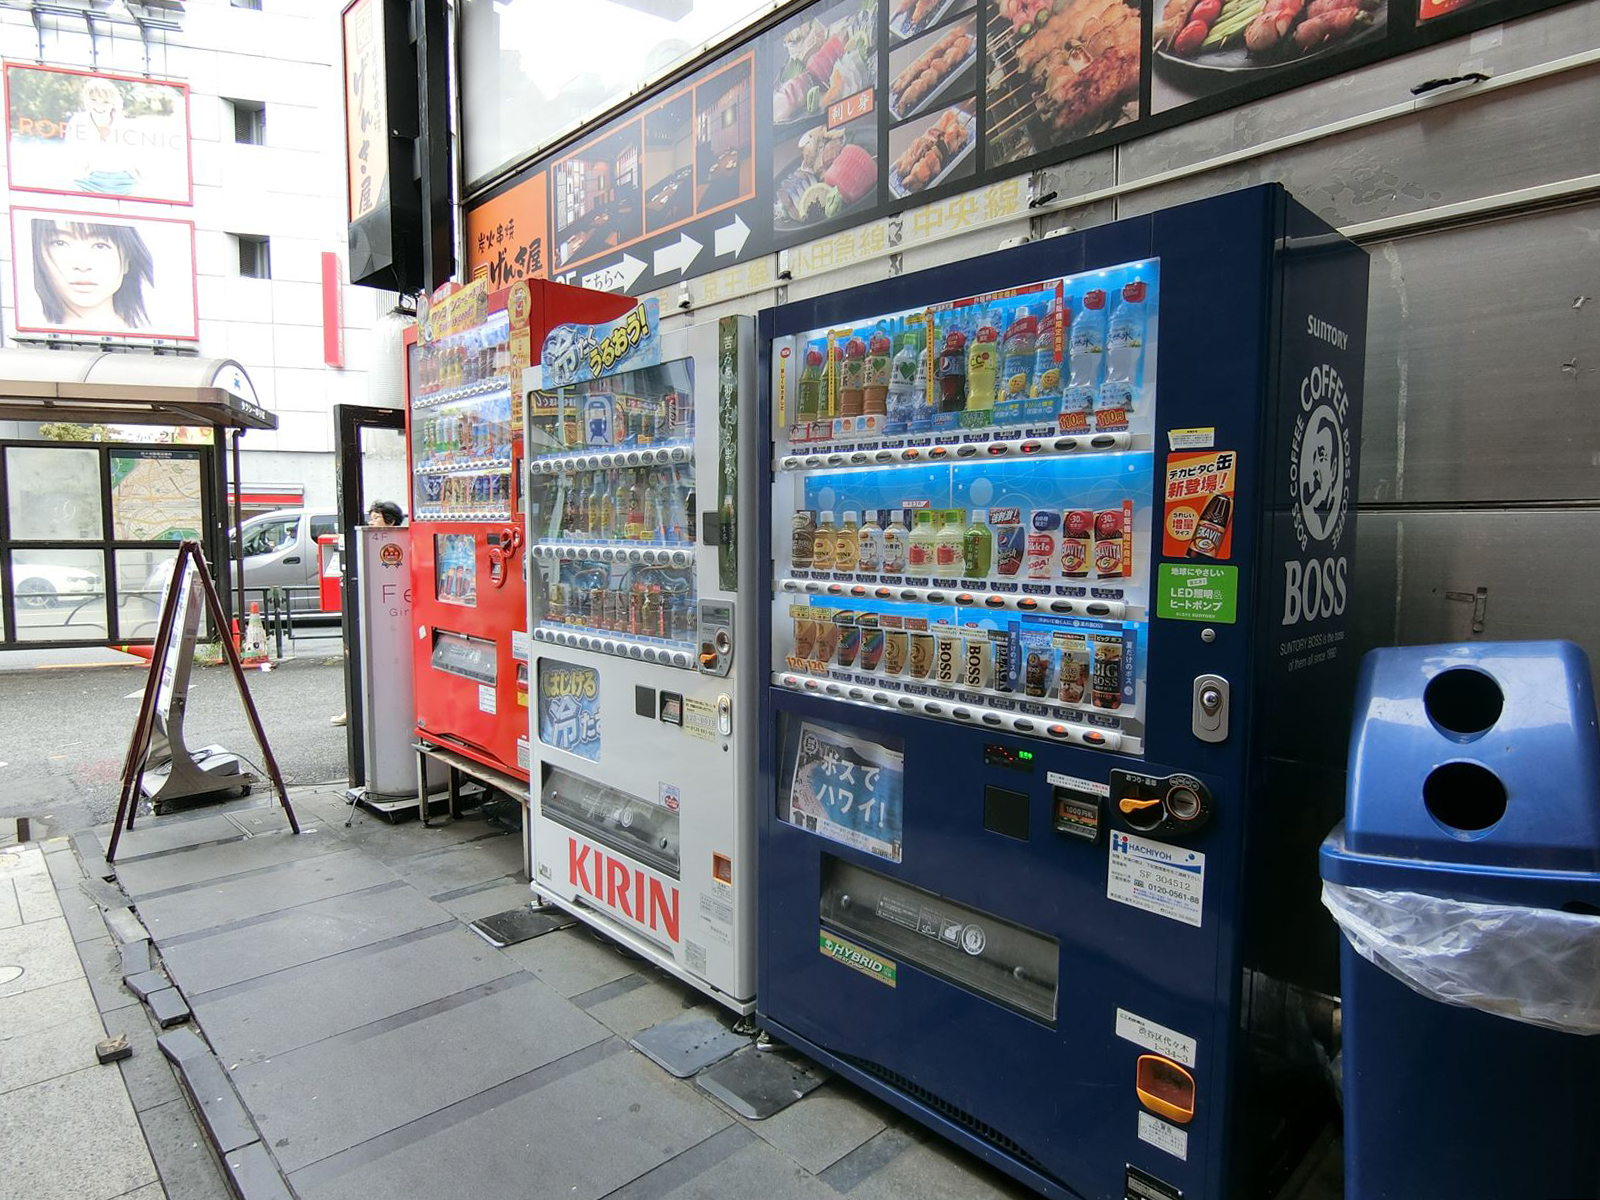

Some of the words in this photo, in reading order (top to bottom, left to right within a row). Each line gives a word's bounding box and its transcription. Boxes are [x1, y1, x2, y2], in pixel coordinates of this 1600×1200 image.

[832, 93, 871, 123] 刺し身
[914, 180, 1020, 236] 中央線
[478, 218, 514, 254] 炭火串焼
[490, 237, 543, 290] げんき屋
[588, 303, 650, 378] うるおう!
[1307, 314, 1350, 350] SUNTORY
[1300, 364, 1350, 425] COFFEE
[1096, 409, 1125, 427] 110円
[1289, 413, 1305, 497] COFFEE
[1167, 472, 1228, 498] 新登場!
[1172, 519, 1194, 530] 増量
[1291, 502, 1309, 552] BOSS
[1171, 567, 1225, 577] 地球にやさしい
[1170, 600, 1223, 611] ヒートポンプ
[1282, 556, 1348, 626] BOSS
[1279, 639, 1307, 656] SUNTORY
[1308, 633, 1323, 649] BOSS
[940, 641, 952, 681] BOSS
[968, 645, 982, 686] BOSS
[1094, 662, 1119, 676] BIG
[1125, 641, 1134, 684] 夏だけのボス
[543, 669, 598, 701] はじける
[1093, 675, 1119, 688] BOSS
[820, 751, 881, 791] ボスで
[815, 784, 886, 828] ハワイ!
[1066, 806, 1094, 819] 1000円札
[1128, 844, 1172, 861] HACHIYOH
[569, 837, 680, 944] KIRIN
[1139, 869, 1152, 879] SF
[1155, 874, 1191, 892] 304512
[1148, 883, 1200, 905] 0120-0561-88
[832, 944, 883, 972] HYBRID
[1138, 1026, 1189, 1053] 渋谷区代々木
[1153, 1043, 1189, 1063] 1-34-3
